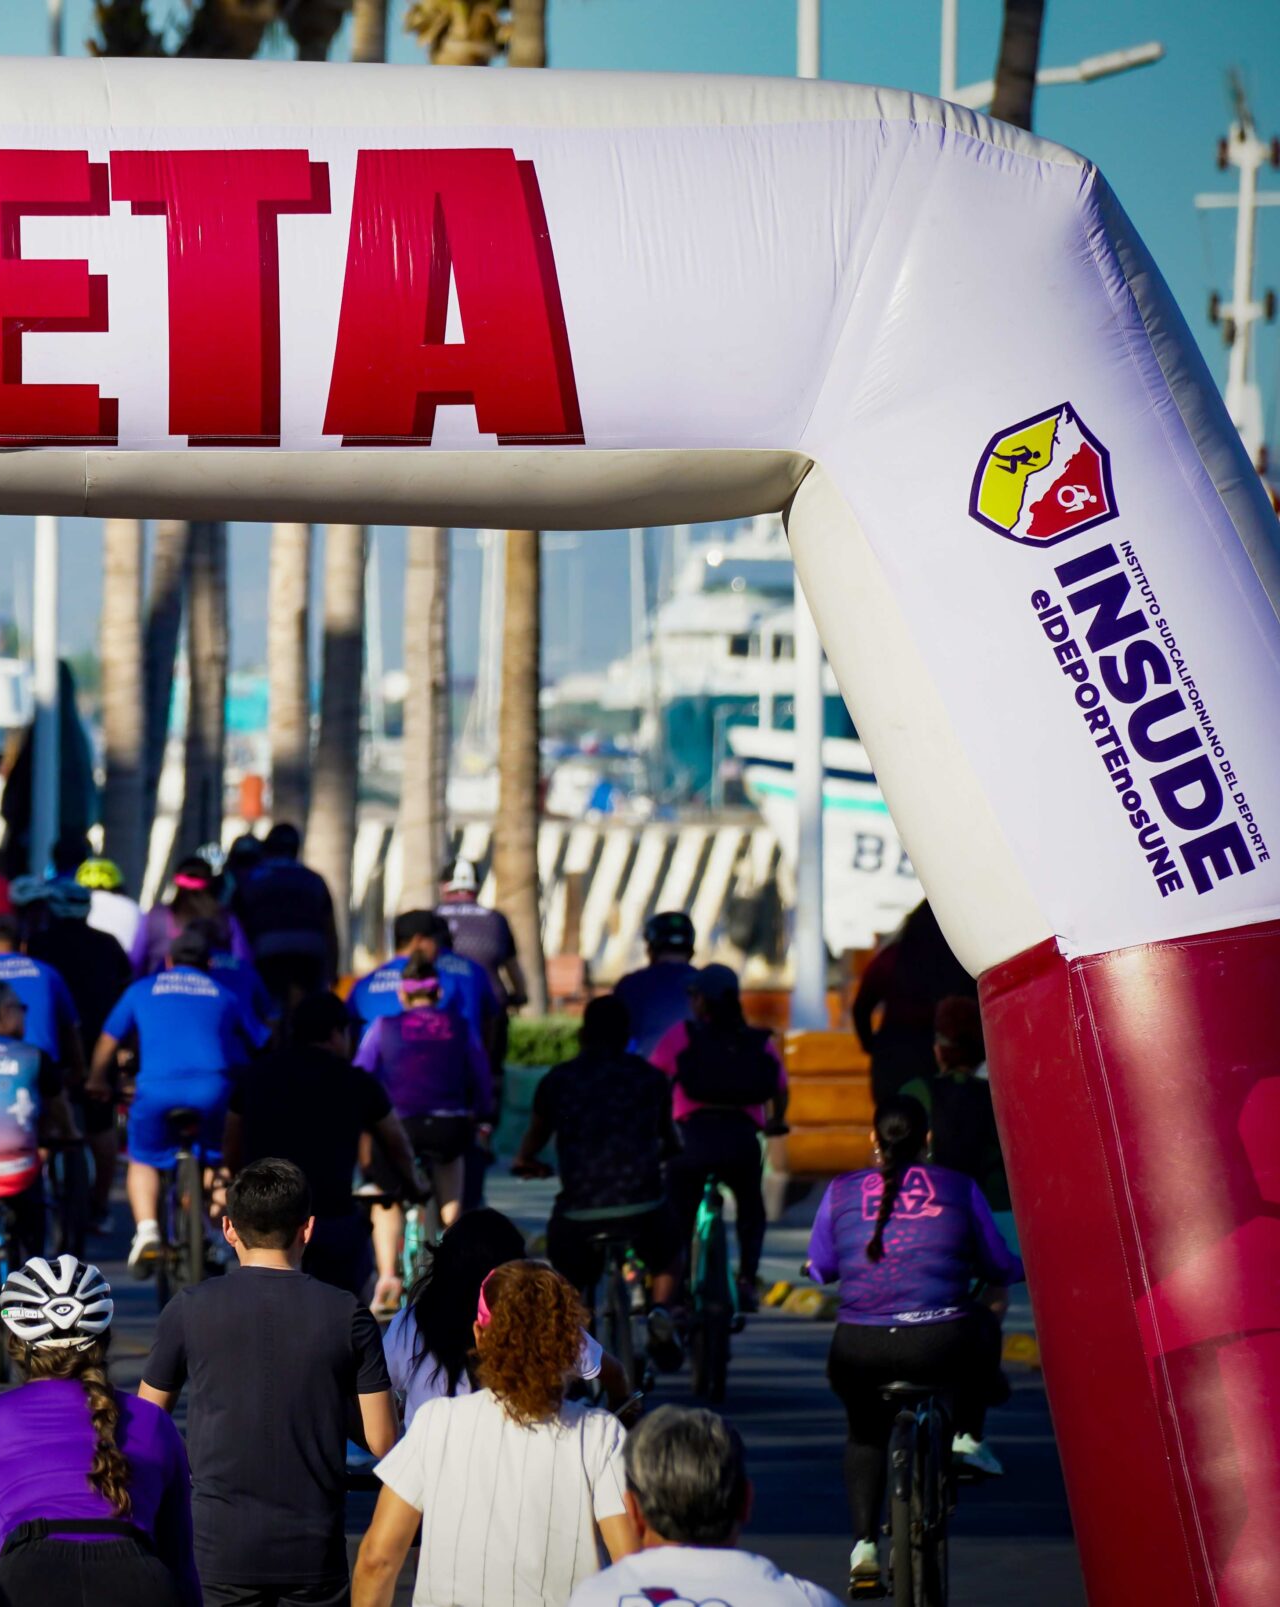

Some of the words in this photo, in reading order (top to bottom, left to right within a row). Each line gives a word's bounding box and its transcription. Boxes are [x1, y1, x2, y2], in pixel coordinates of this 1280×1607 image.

[1053, 543, 1256, 896] INSUDE
[1120, 540, 1161, 616] INSTITUTO
[1155, 618, 1225, 758] SUDCALIFORNIANO
[1218, 760, 1238, 792] DEL
[1232, 792, 1271, 863] DEPORTE
